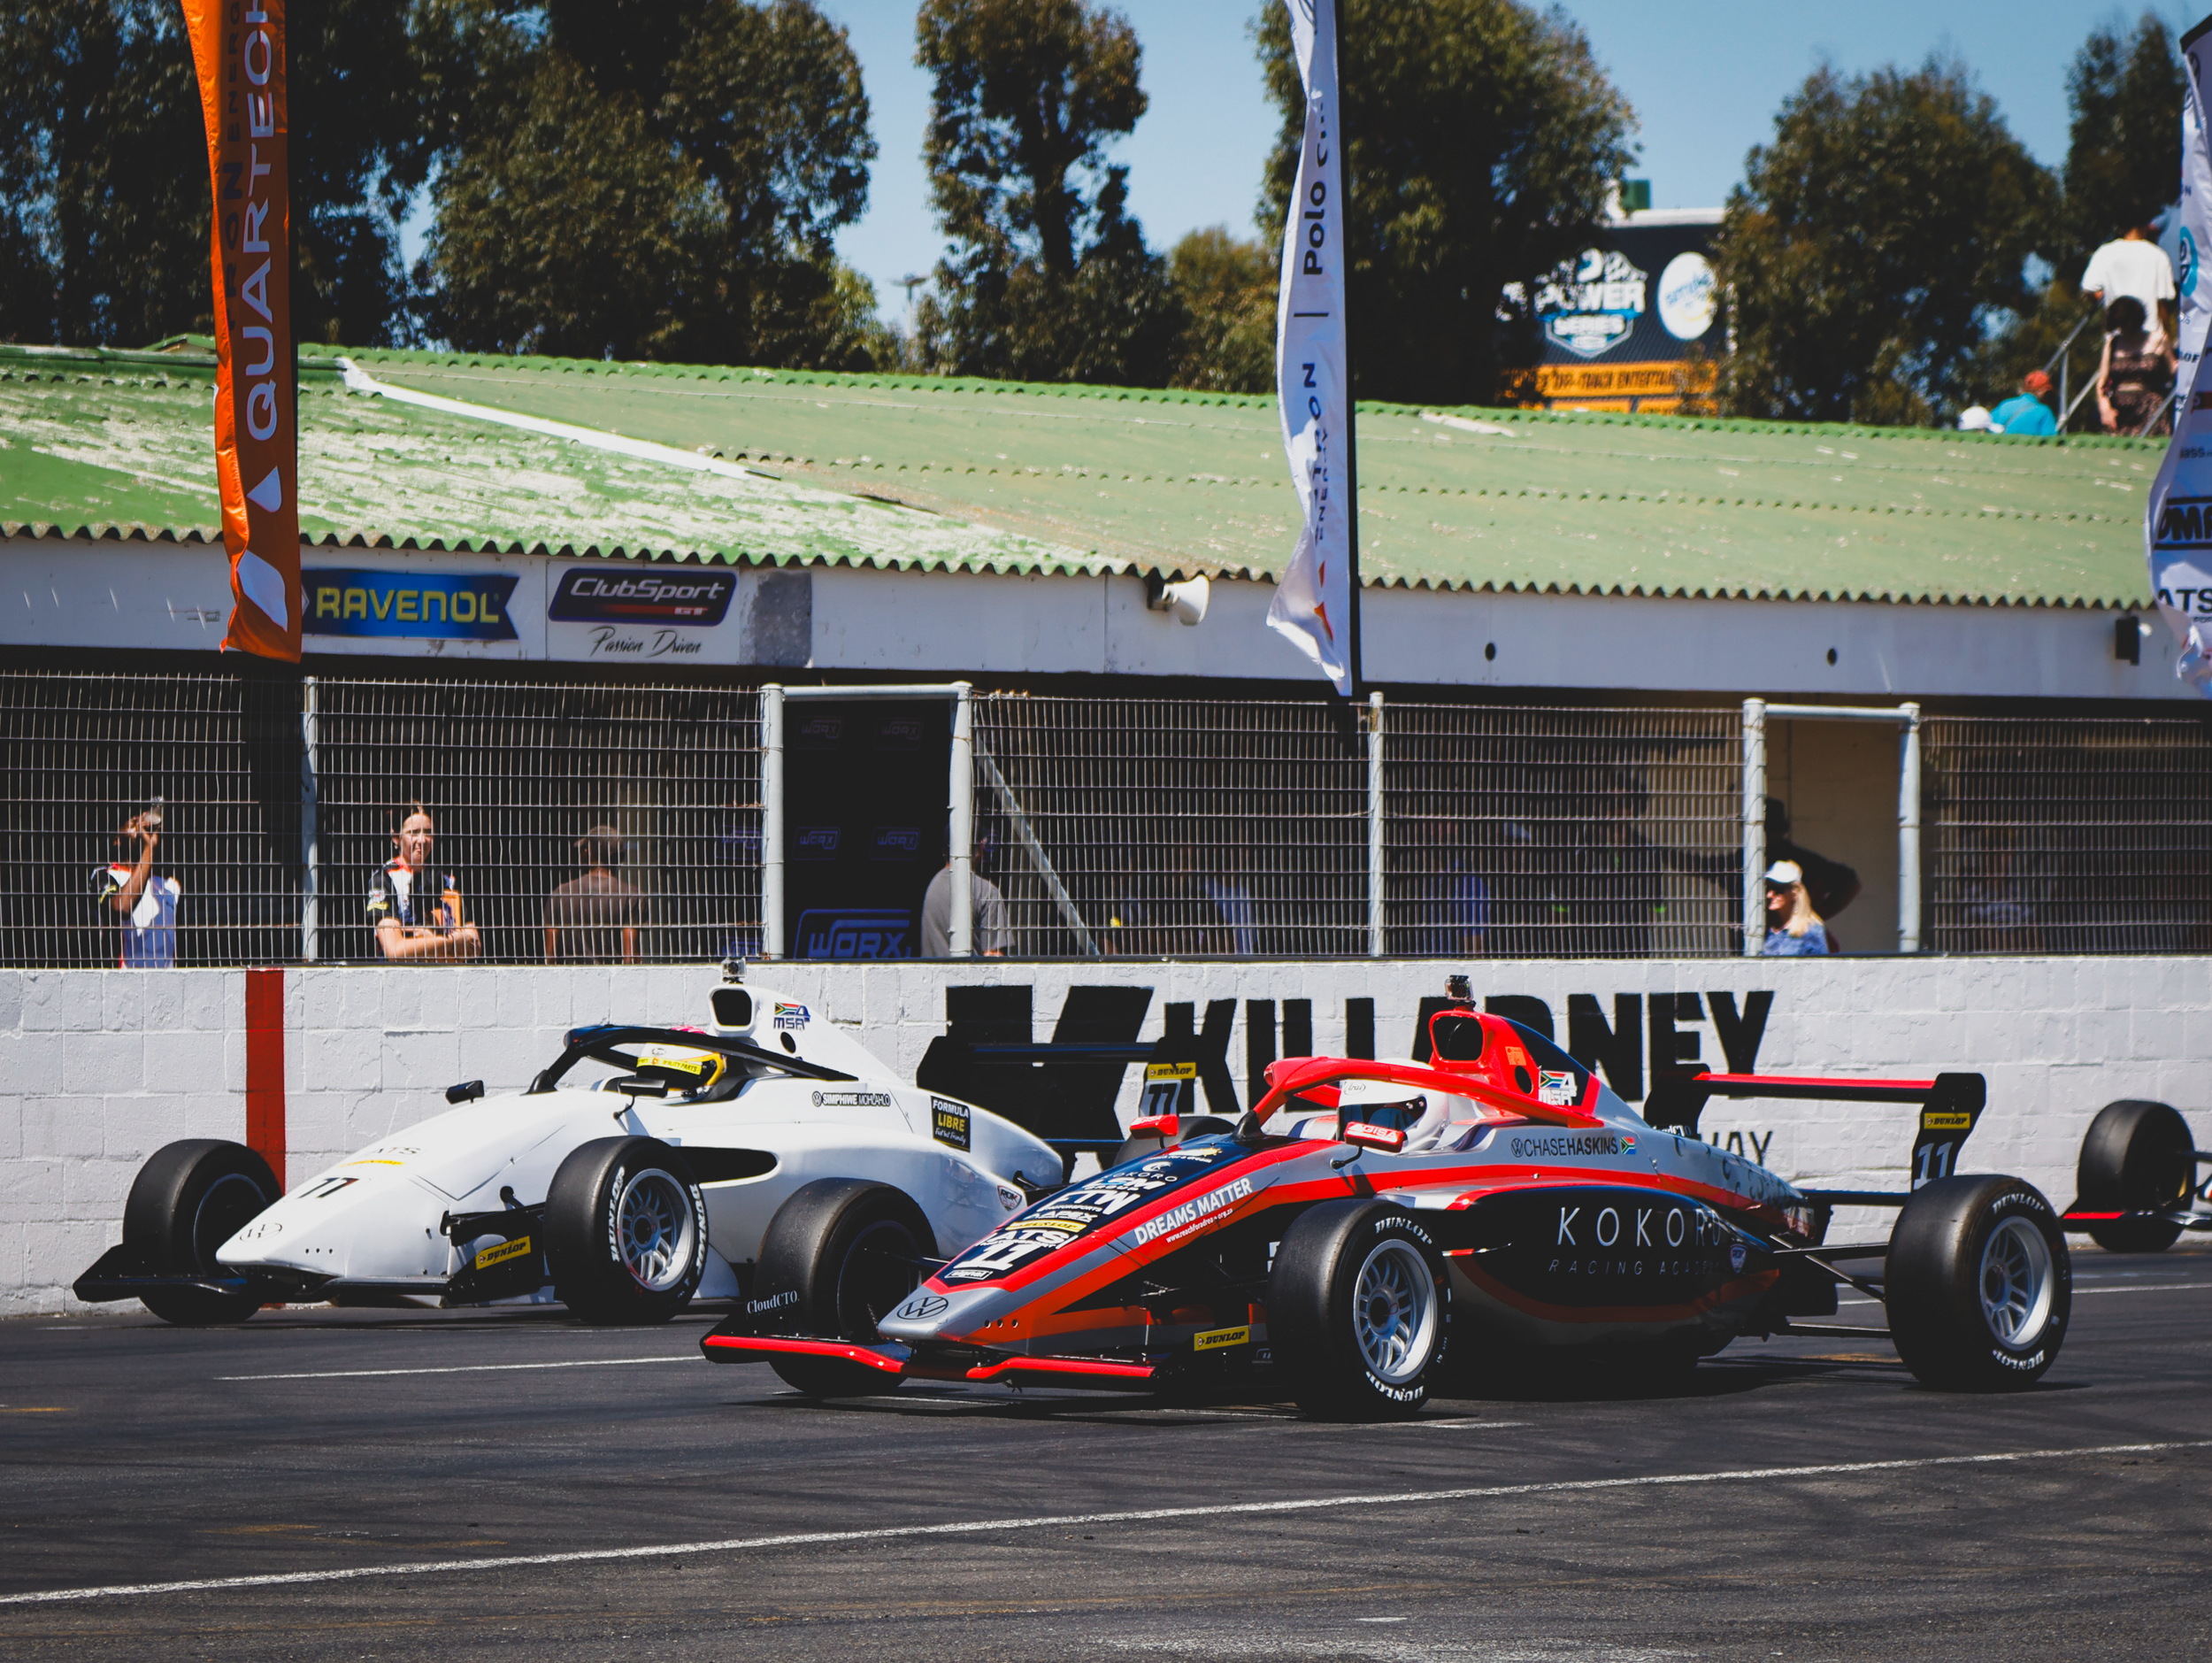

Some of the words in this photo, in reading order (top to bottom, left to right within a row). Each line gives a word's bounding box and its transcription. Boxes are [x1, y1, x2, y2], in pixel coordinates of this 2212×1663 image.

[1302, 181, 1326, 275] Polo
[570, 578, 725, 602] ClubSport
[316, 588, 500, 624] RAVENOL
[588, 626, 643, 658] Passion
[645, 629, 703, 658] Driven
[799, 834, 835, 847] WORX
[877, 834, 916, 847] WORX
[810, 932, 906, 958] WORX
[1156, 1067, 1192, 1076] DUNLOP
[822, 1093, 857, 1105] SIMPHIWE
[933, 1099, 969, 1119] FORMULA
[1148, 1083, 1178, 1116] 77
[938, 1113, 965, 1132] LIBRE
[1933, 1117, 1968, 1126] DUNLOP
[1913, 1141, 1954, 1190] 11
[608, 1165, 626, 1263] DUNLOP
[1133, 1203, 1196, 1245] DREAMS
[1196, 1177, 1253, 1217] MATTER
[1992, 1192, 2046, 1216] DUNLOP
[688, 1182, 708, 1277] DUNLOP
[1374, 1216, 1432, 1245] DUNLOP
[1556, 1206, 1721, 1247] KOKORO
[486, 1242, 527, 1262] DUNLOP
[953, 1241, 1045, 1271] 11
[1548, 1259, 1643, 1275] RACING
[1659, 1260, 1722, 1275] ACADE
[1204, 1331, 1246, 1344] DUNLOP
[1992, 1348, 2046, 1371] DUNLOP
[1365, 1370, 1425, 1402] DUNLOP
